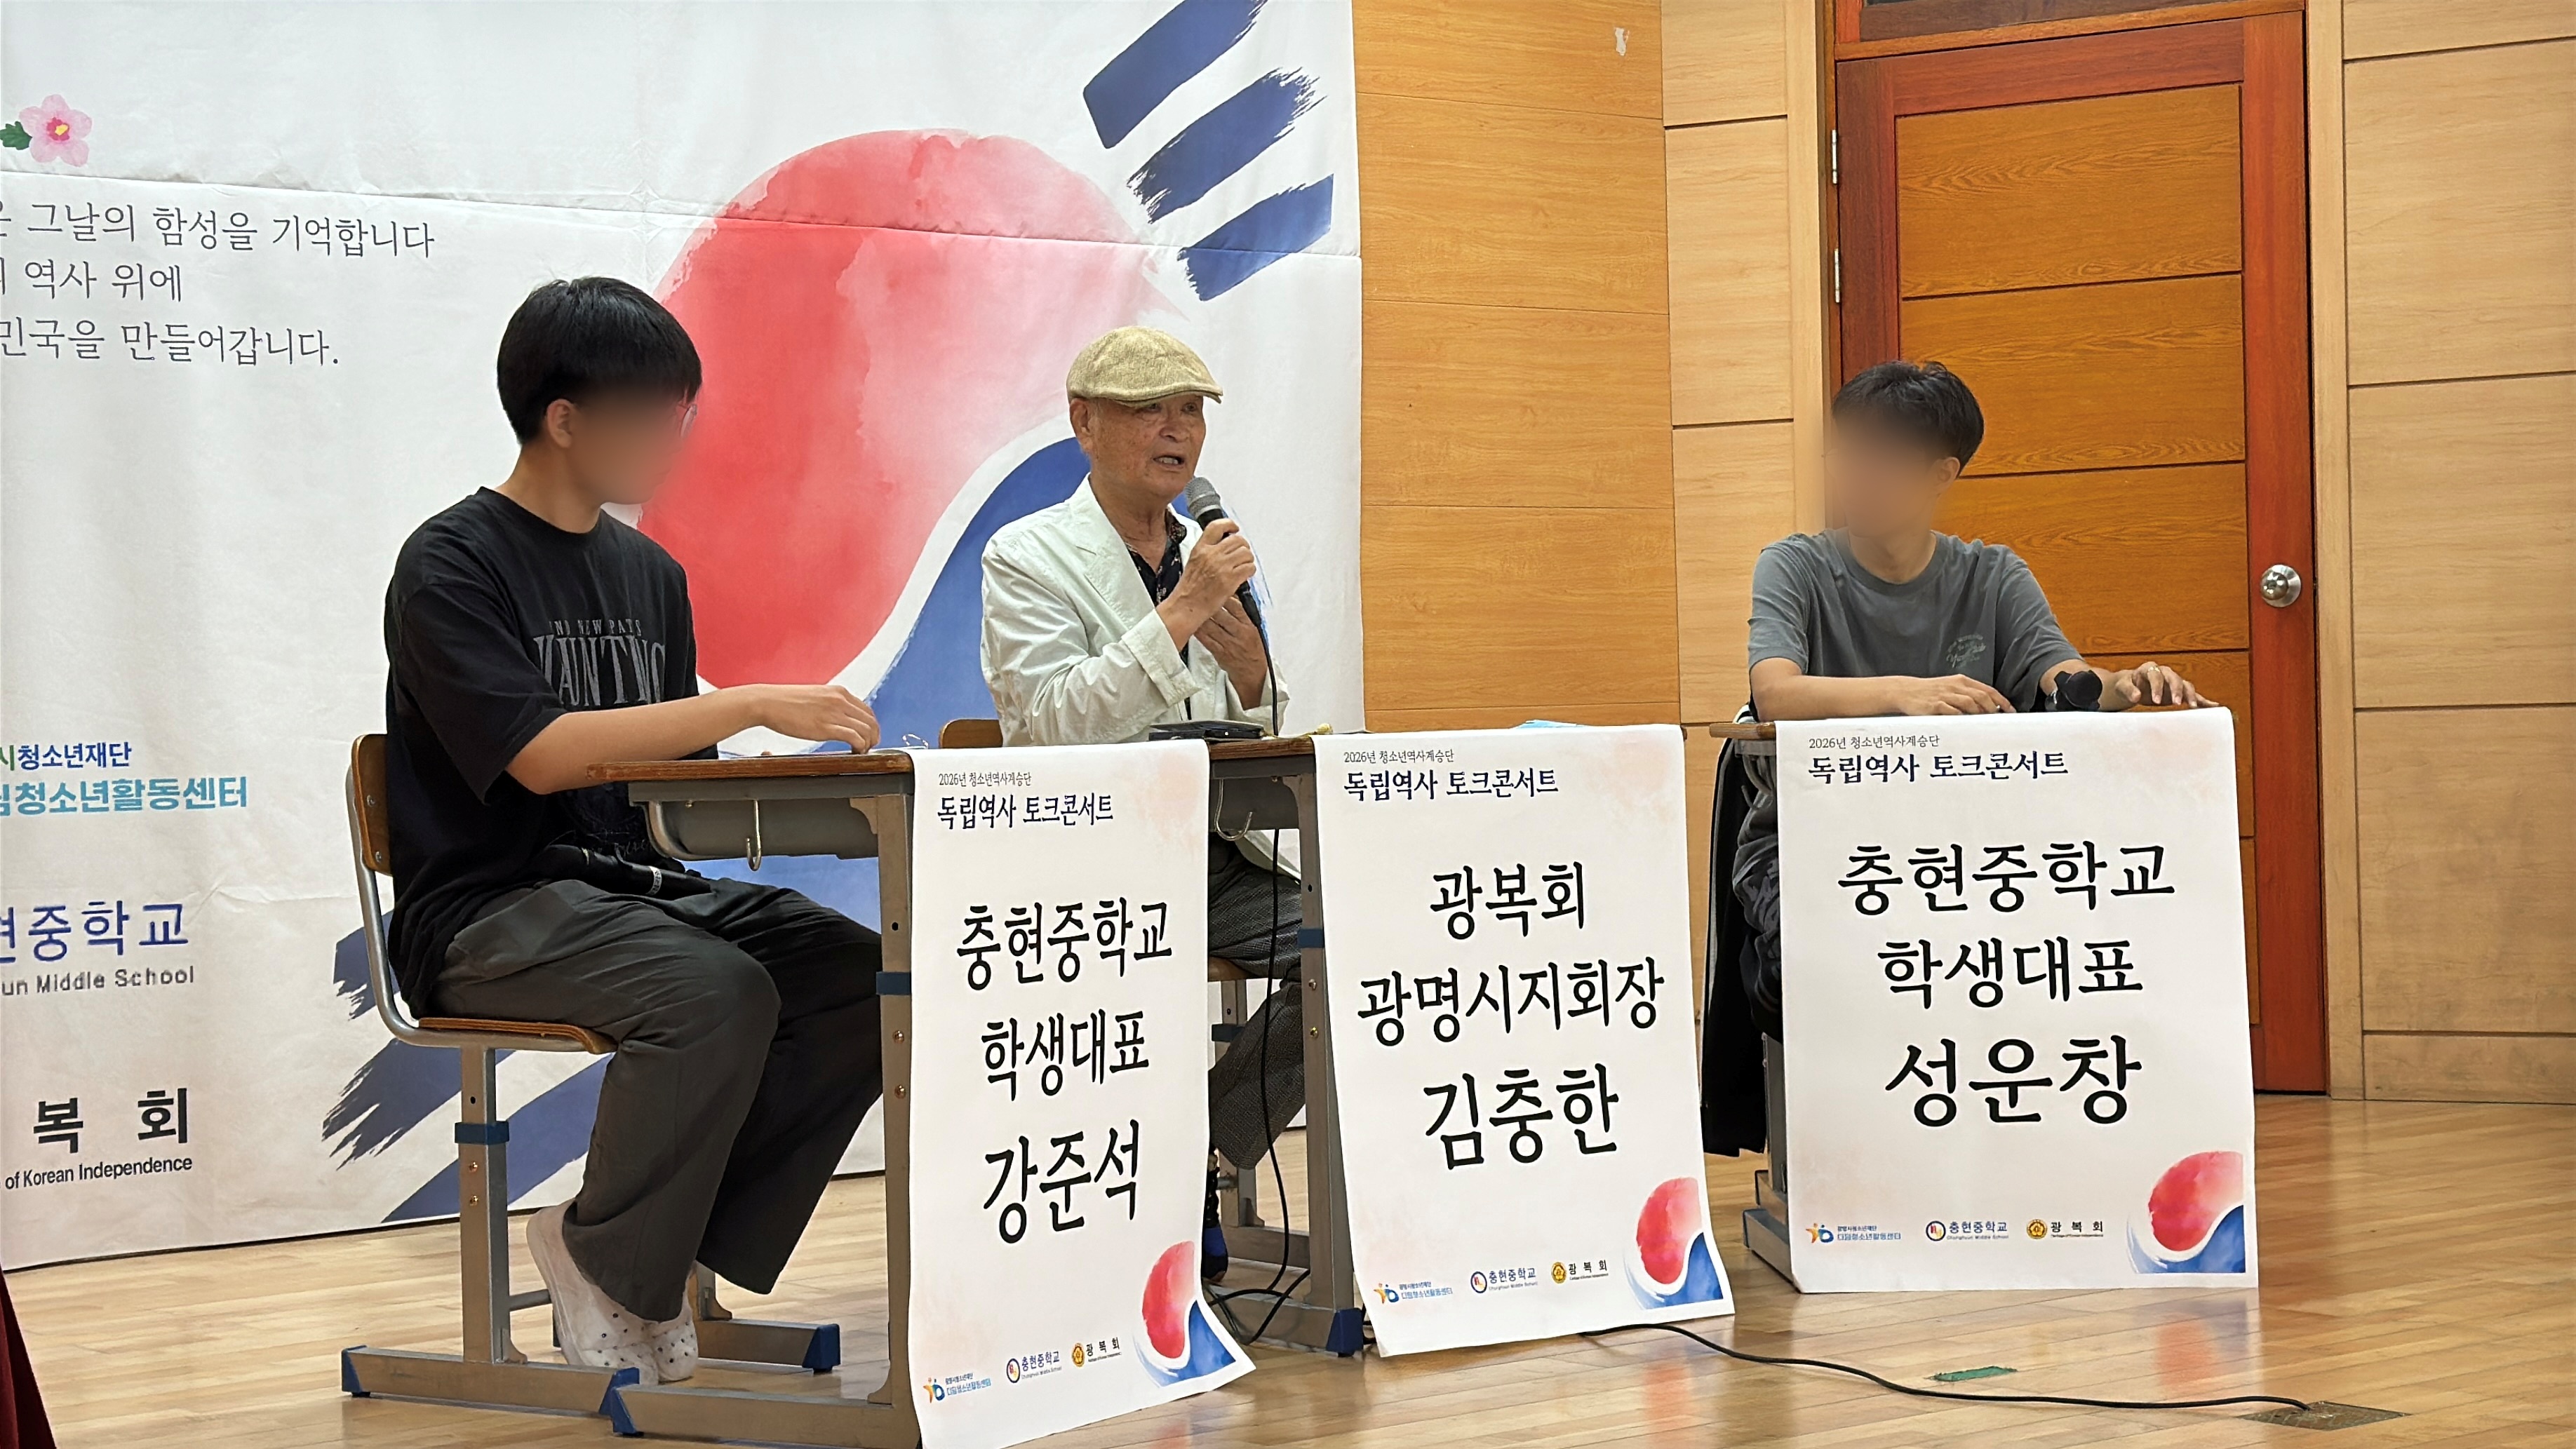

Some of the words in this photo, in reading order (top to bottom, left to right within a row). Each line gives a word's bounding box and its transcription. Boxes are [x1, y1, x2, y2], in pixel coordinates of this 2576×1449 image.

[27, 202, 135, 242] 그날의
[152, 207, 258, 251] 함성을
[272, 215, 435, 258] 기억합니다
[25, 259, 98, 299] 역사
[112, 263, 181, 302] 위에
[121, 321, 338, 366] 만들어갑니다.
[1343, 750, 1376, 764] 2026년
[1379, 748, 1454, 764] 청소년역사계승단
[1809, 735, 1847, 750] 2026년
[1851, 734, 1940, 749] 청소년역사계승단
[939, 772, 967, 787] 2026년
[1343, 769, 1438, 802] 독립역사
[1446, 767, 1559, 798] 토크콘서트
[1808, 753, 1920, 784] 독립역사
[1930, 750, 2069, 780] 토크콘서트
[937, 794, 1017, 830] 독립역사
[1022, 792, 1113, 826] 토크콘서트
[1837, 840, 2175, 916] 충현중학교
[1430, 861, 1584, 941] 광복회
[956, 896, 1172, 991] 충현중학교
[36, 971, 105, 994] Middle
[114, 965, 194, 988] School
[1877, 936, 2143, 1010] 학생대표
[1357, 956, 1665, 1047] 광명시지회장
[981, 1009, 1150, 1102] 학생대표
[1885, 1034, 2142, 1127] 성운창
[1423, 1063, 1619, 1171] 김충한
[4, 1171, 20, 1191] of
[22, 1167, 75, 1189] Korean
[79, 1157, 193, 1180] Independence
[983, 1119, 1139, 1244] 강준석
[1949, 1221, 2008, 1234] 충현중학교
[1489, 1267, 1536, 1284] 충현중학교
[1021, 1351, 1060, 1372] 충현중학교
